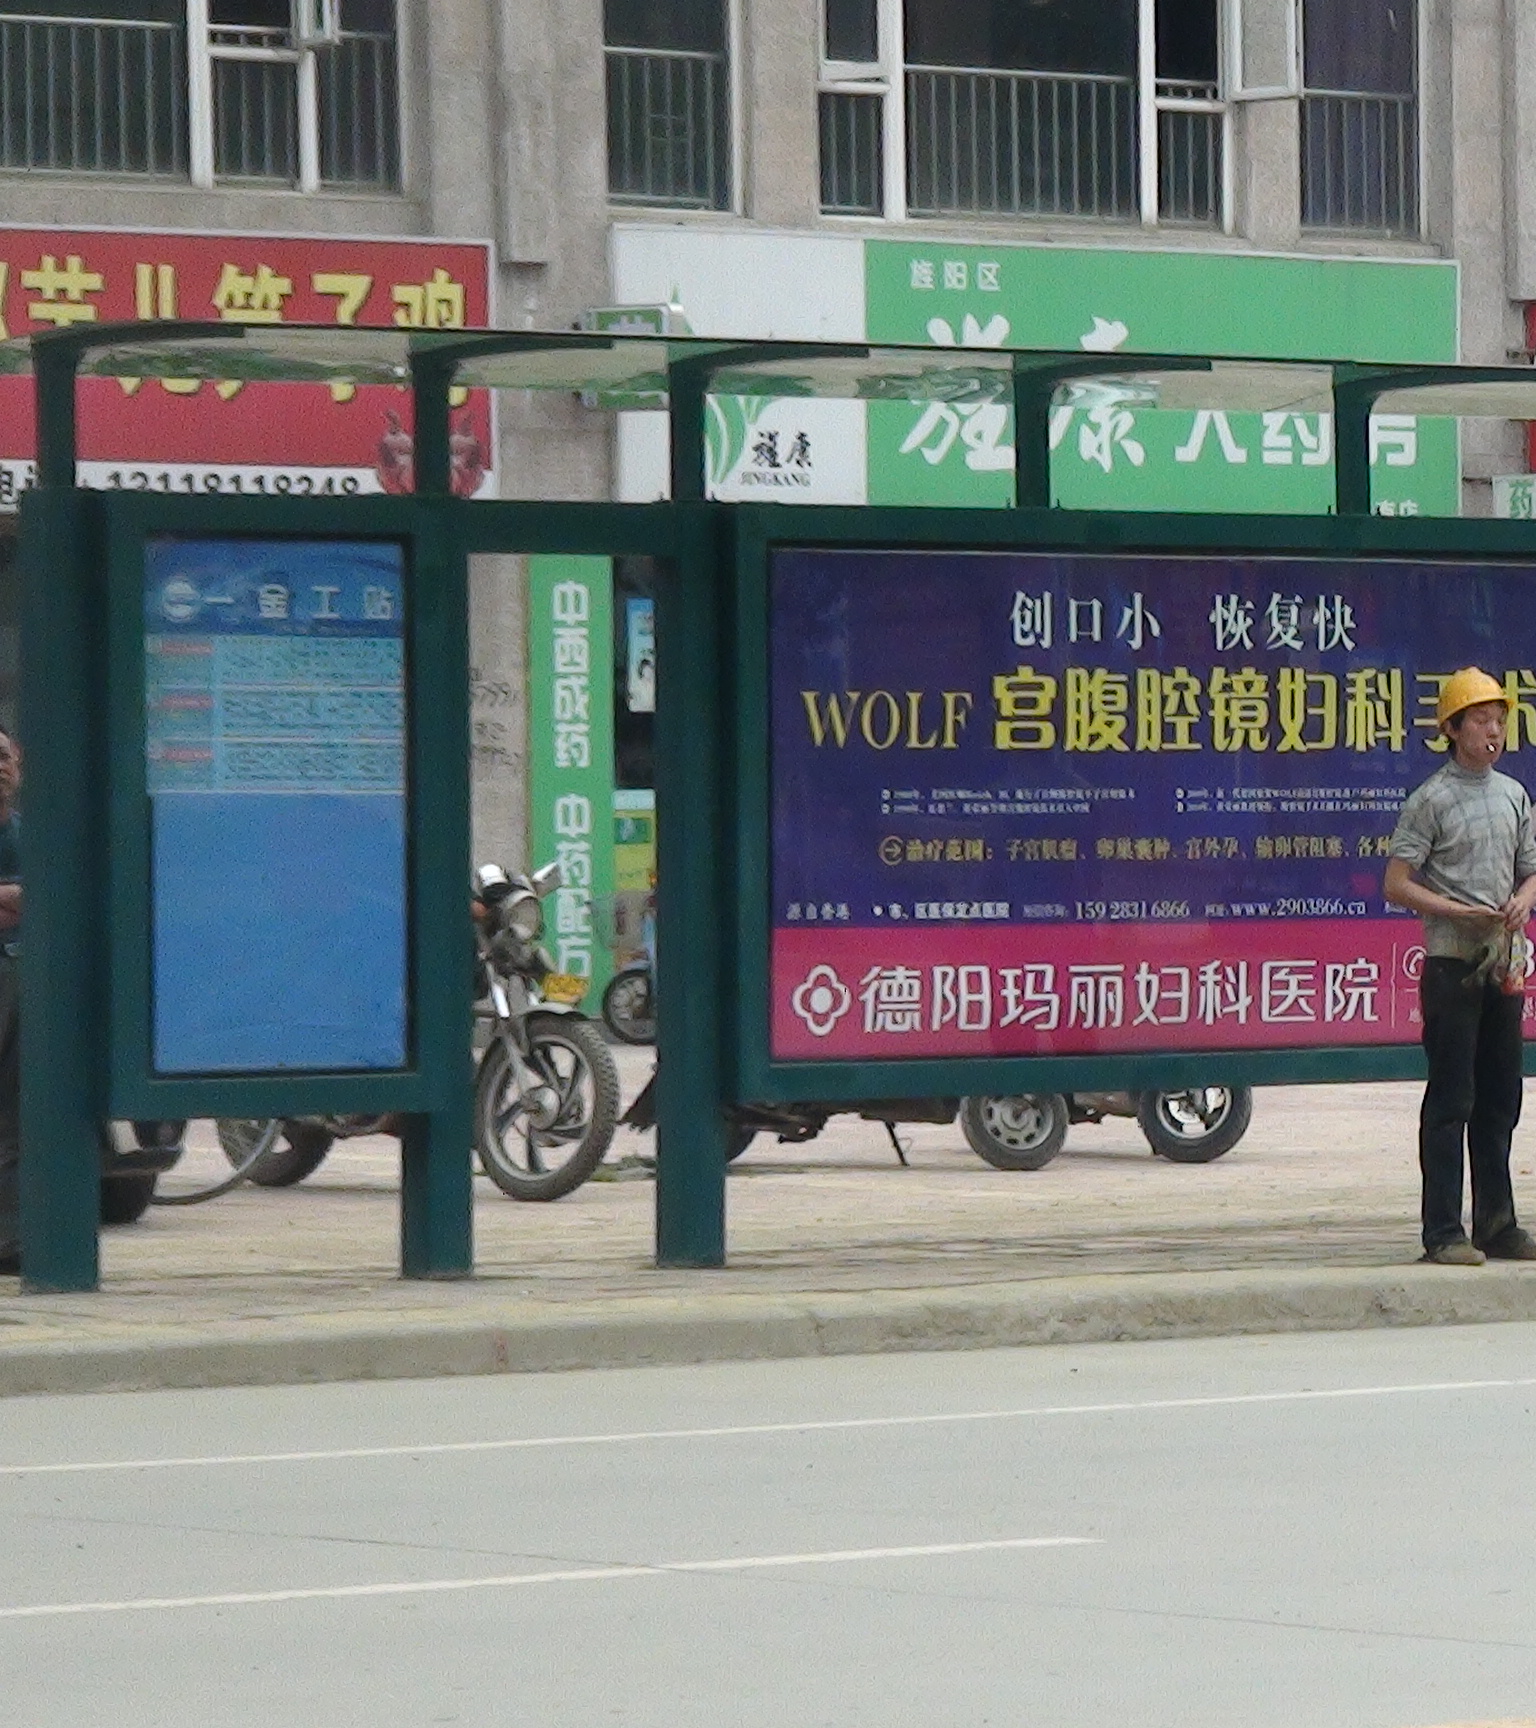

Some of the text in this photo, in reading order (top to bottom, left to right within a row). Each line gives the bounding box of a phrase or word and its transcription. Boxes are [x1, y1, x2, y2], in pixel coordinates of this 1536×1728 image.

[1009, 590, 1358, 652] 创口小 恢复快
[800, 689, 975, 751] WOLF
[552, 579, 593, 978] 中西成药 中药配方
[858, 956, 1380, 1034] 德阳玛丽妇科医院
